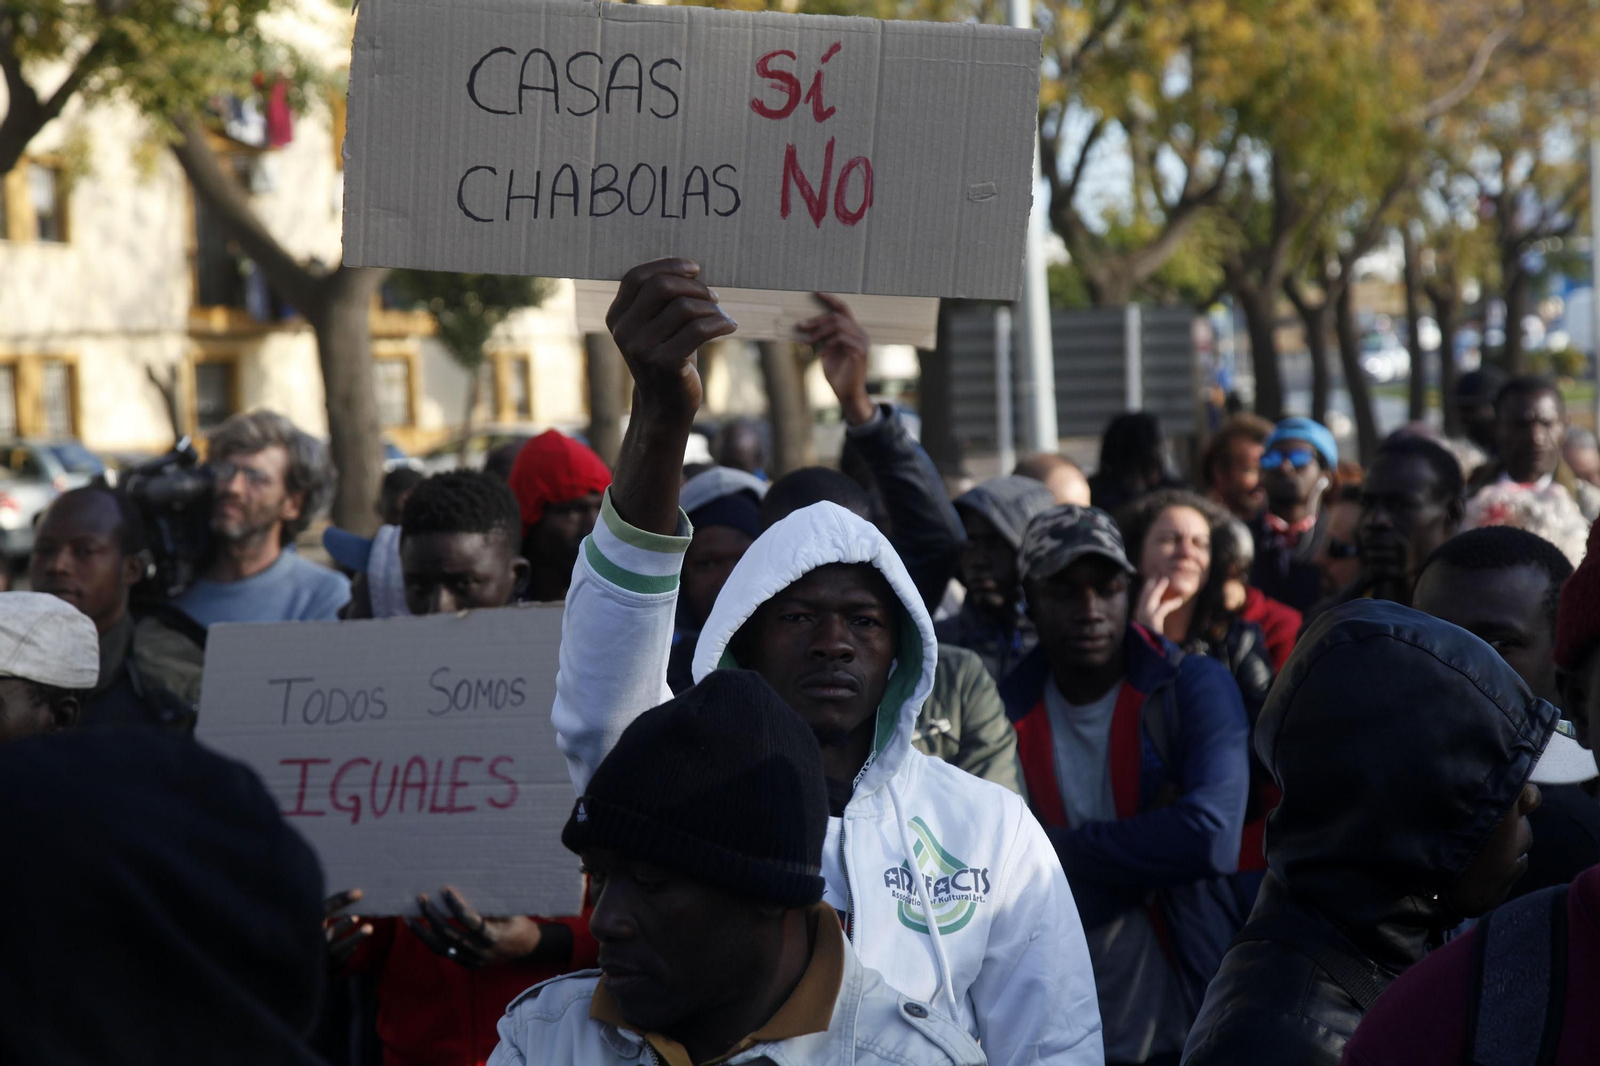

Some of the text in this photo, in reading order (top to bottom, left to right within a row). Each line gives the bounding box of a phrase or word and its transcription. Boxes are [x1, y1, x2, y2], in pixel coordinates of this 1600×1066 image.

[466, 46, 682, 120] CASAS
[456, 163, 741, 223] CHABOLAS
[427, 666, 527, 717] SOMOS
[279, 755, 520, 826] IGUALES
